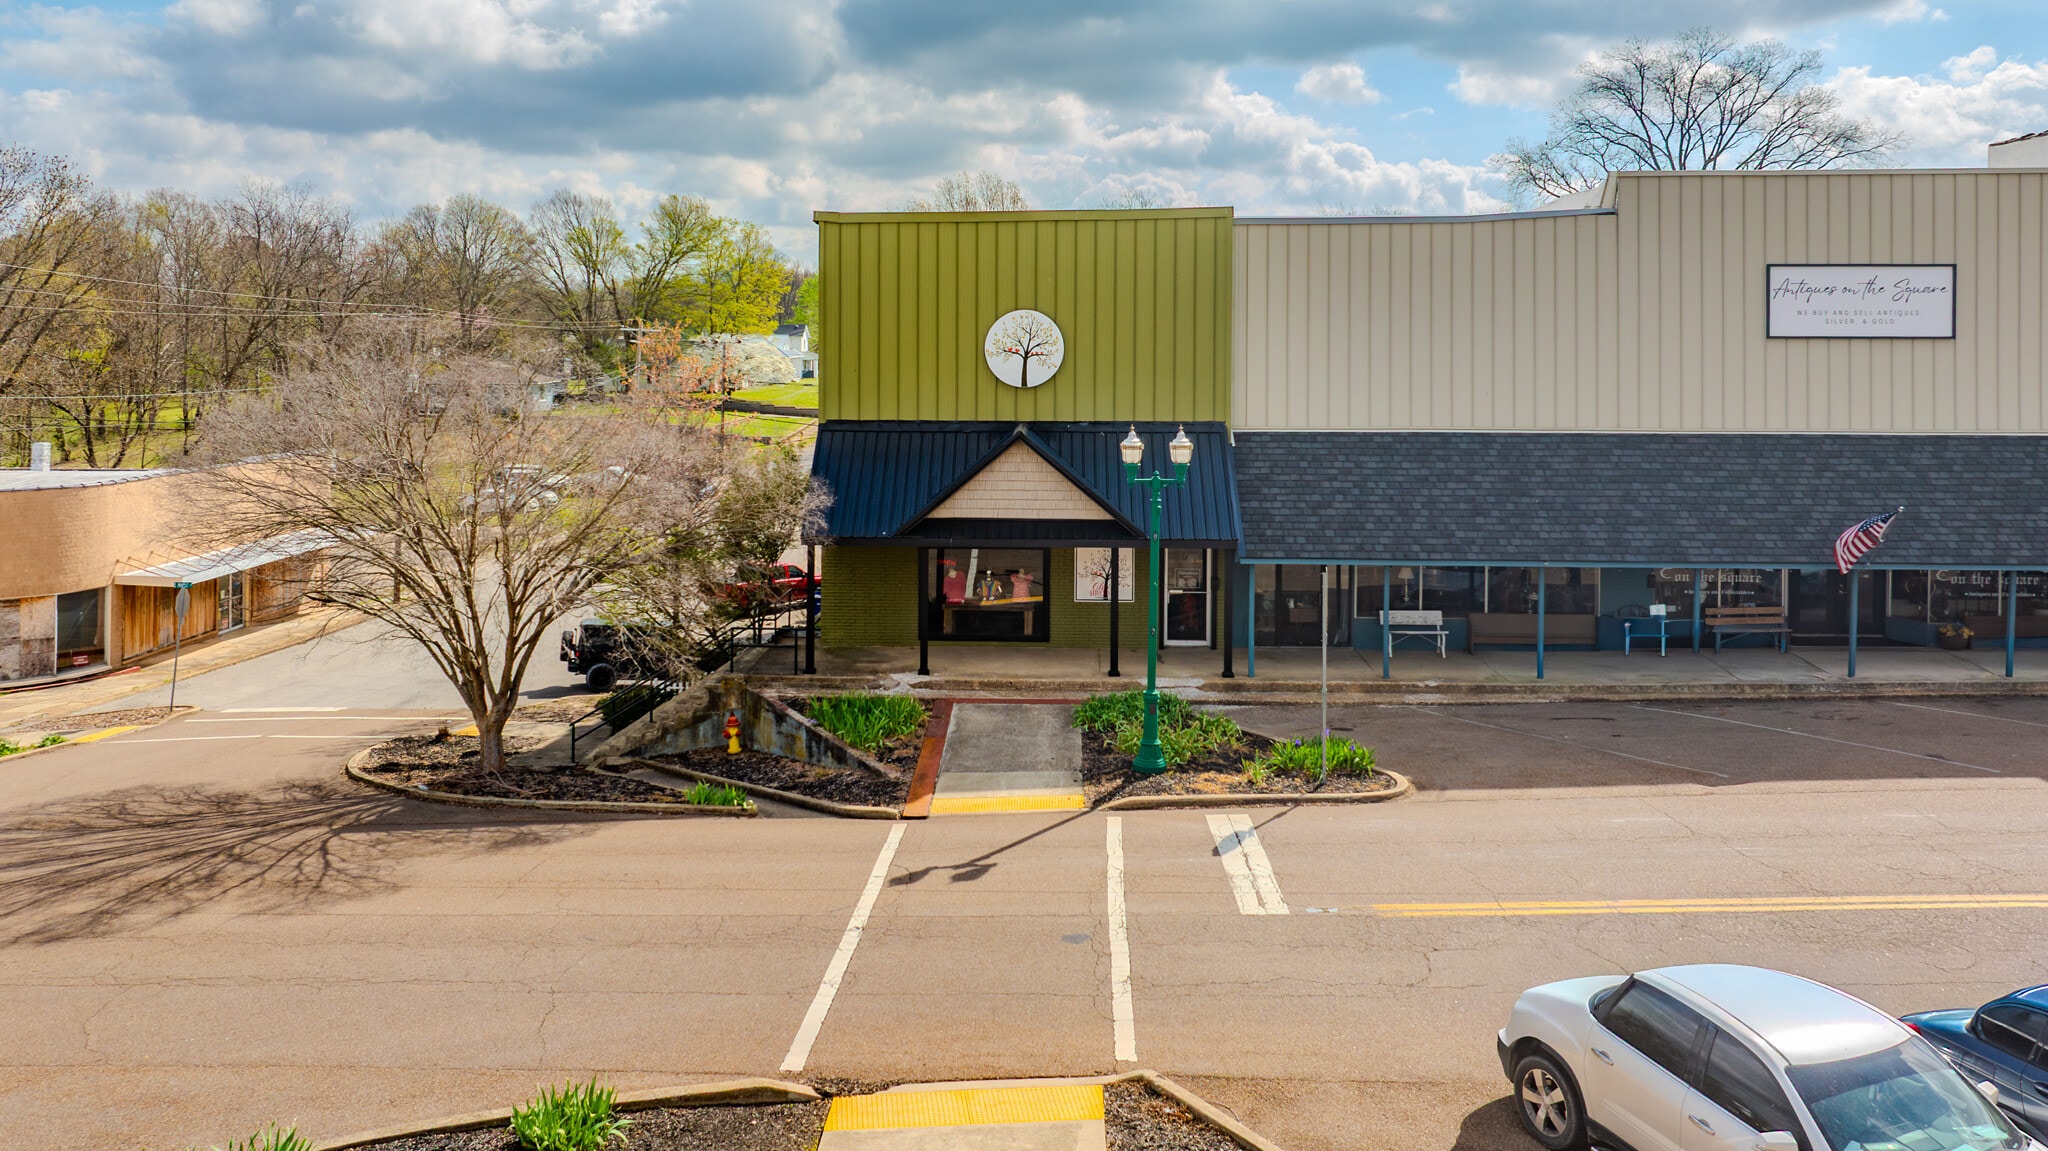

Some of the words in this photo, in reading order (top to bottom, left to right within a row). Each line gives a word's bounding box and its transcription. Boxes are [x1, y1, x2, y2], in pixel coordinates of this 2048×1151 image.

[1773, 277, 1838, 304] Antiques
[1841, 286, 1859, 295] on
[1857, 274, 1886, 301] the
[1891, 277, 1949, 304] Square
[1700, 570, 1715, 582] he
[1721, 573, 1762, 586] square
[1971, 572, 1992, 588] the
